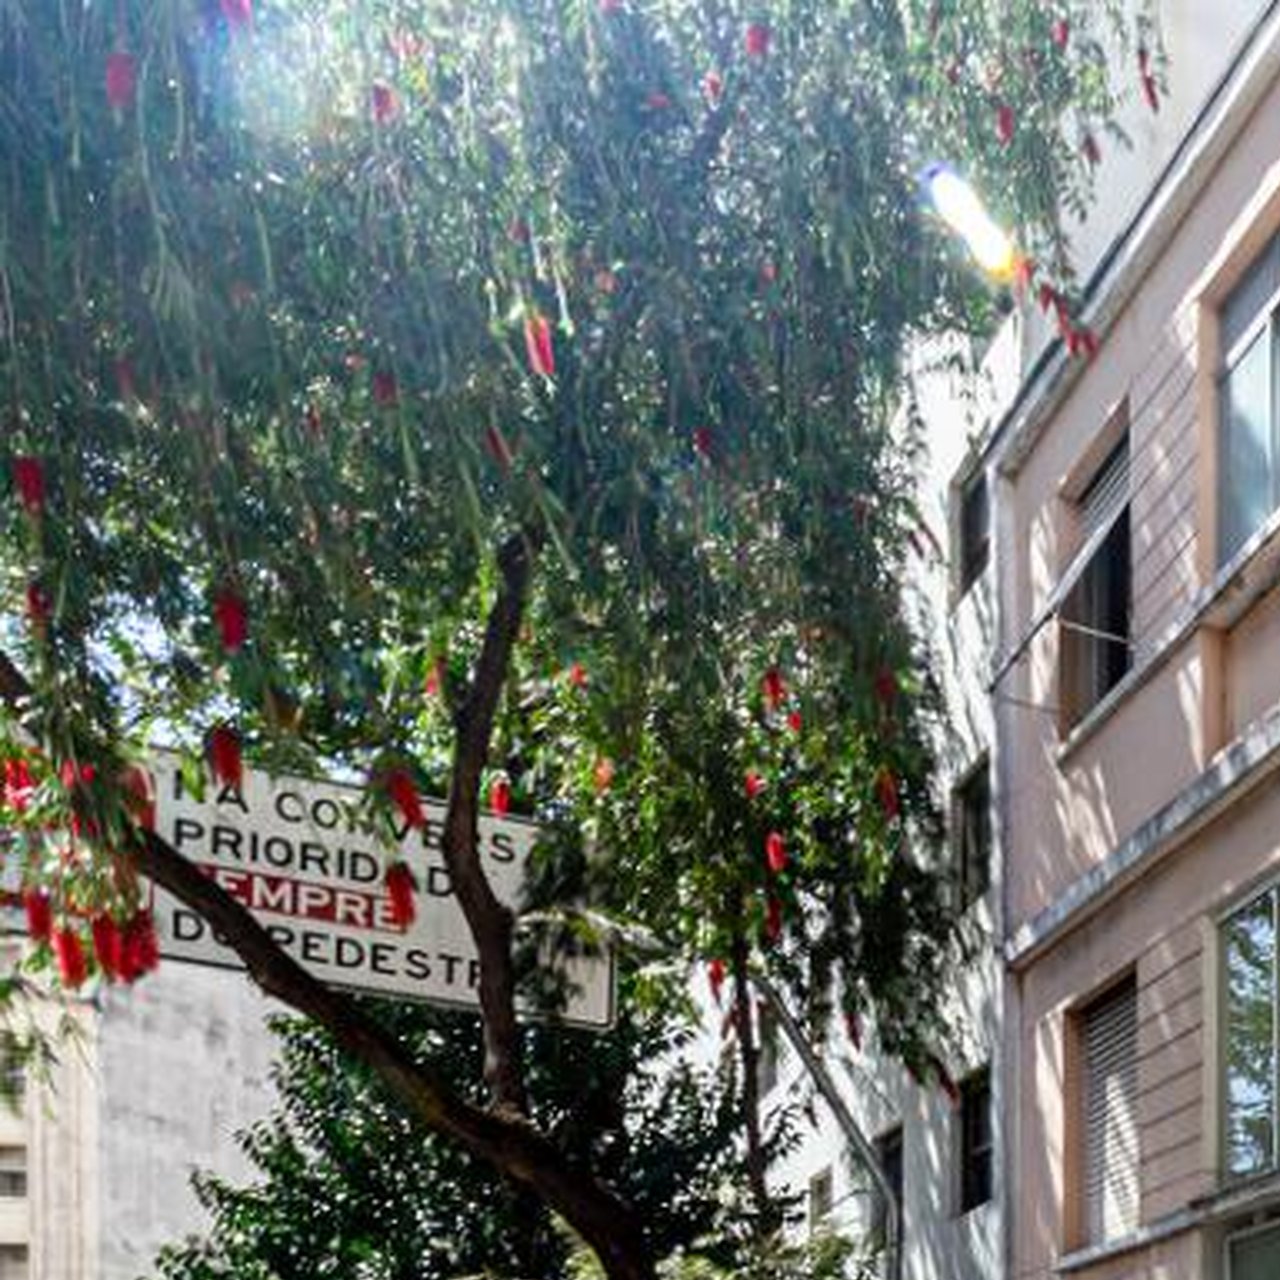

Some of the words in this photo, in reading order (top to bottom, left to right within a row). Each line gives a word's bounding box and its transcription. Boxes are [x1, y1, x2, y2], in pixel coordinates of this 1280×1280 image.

[174, 818, 454, 898] PRIORIDD
[200, 867, 398, 928] EMPRE
[266, 925, 481, 990] PEDEST
